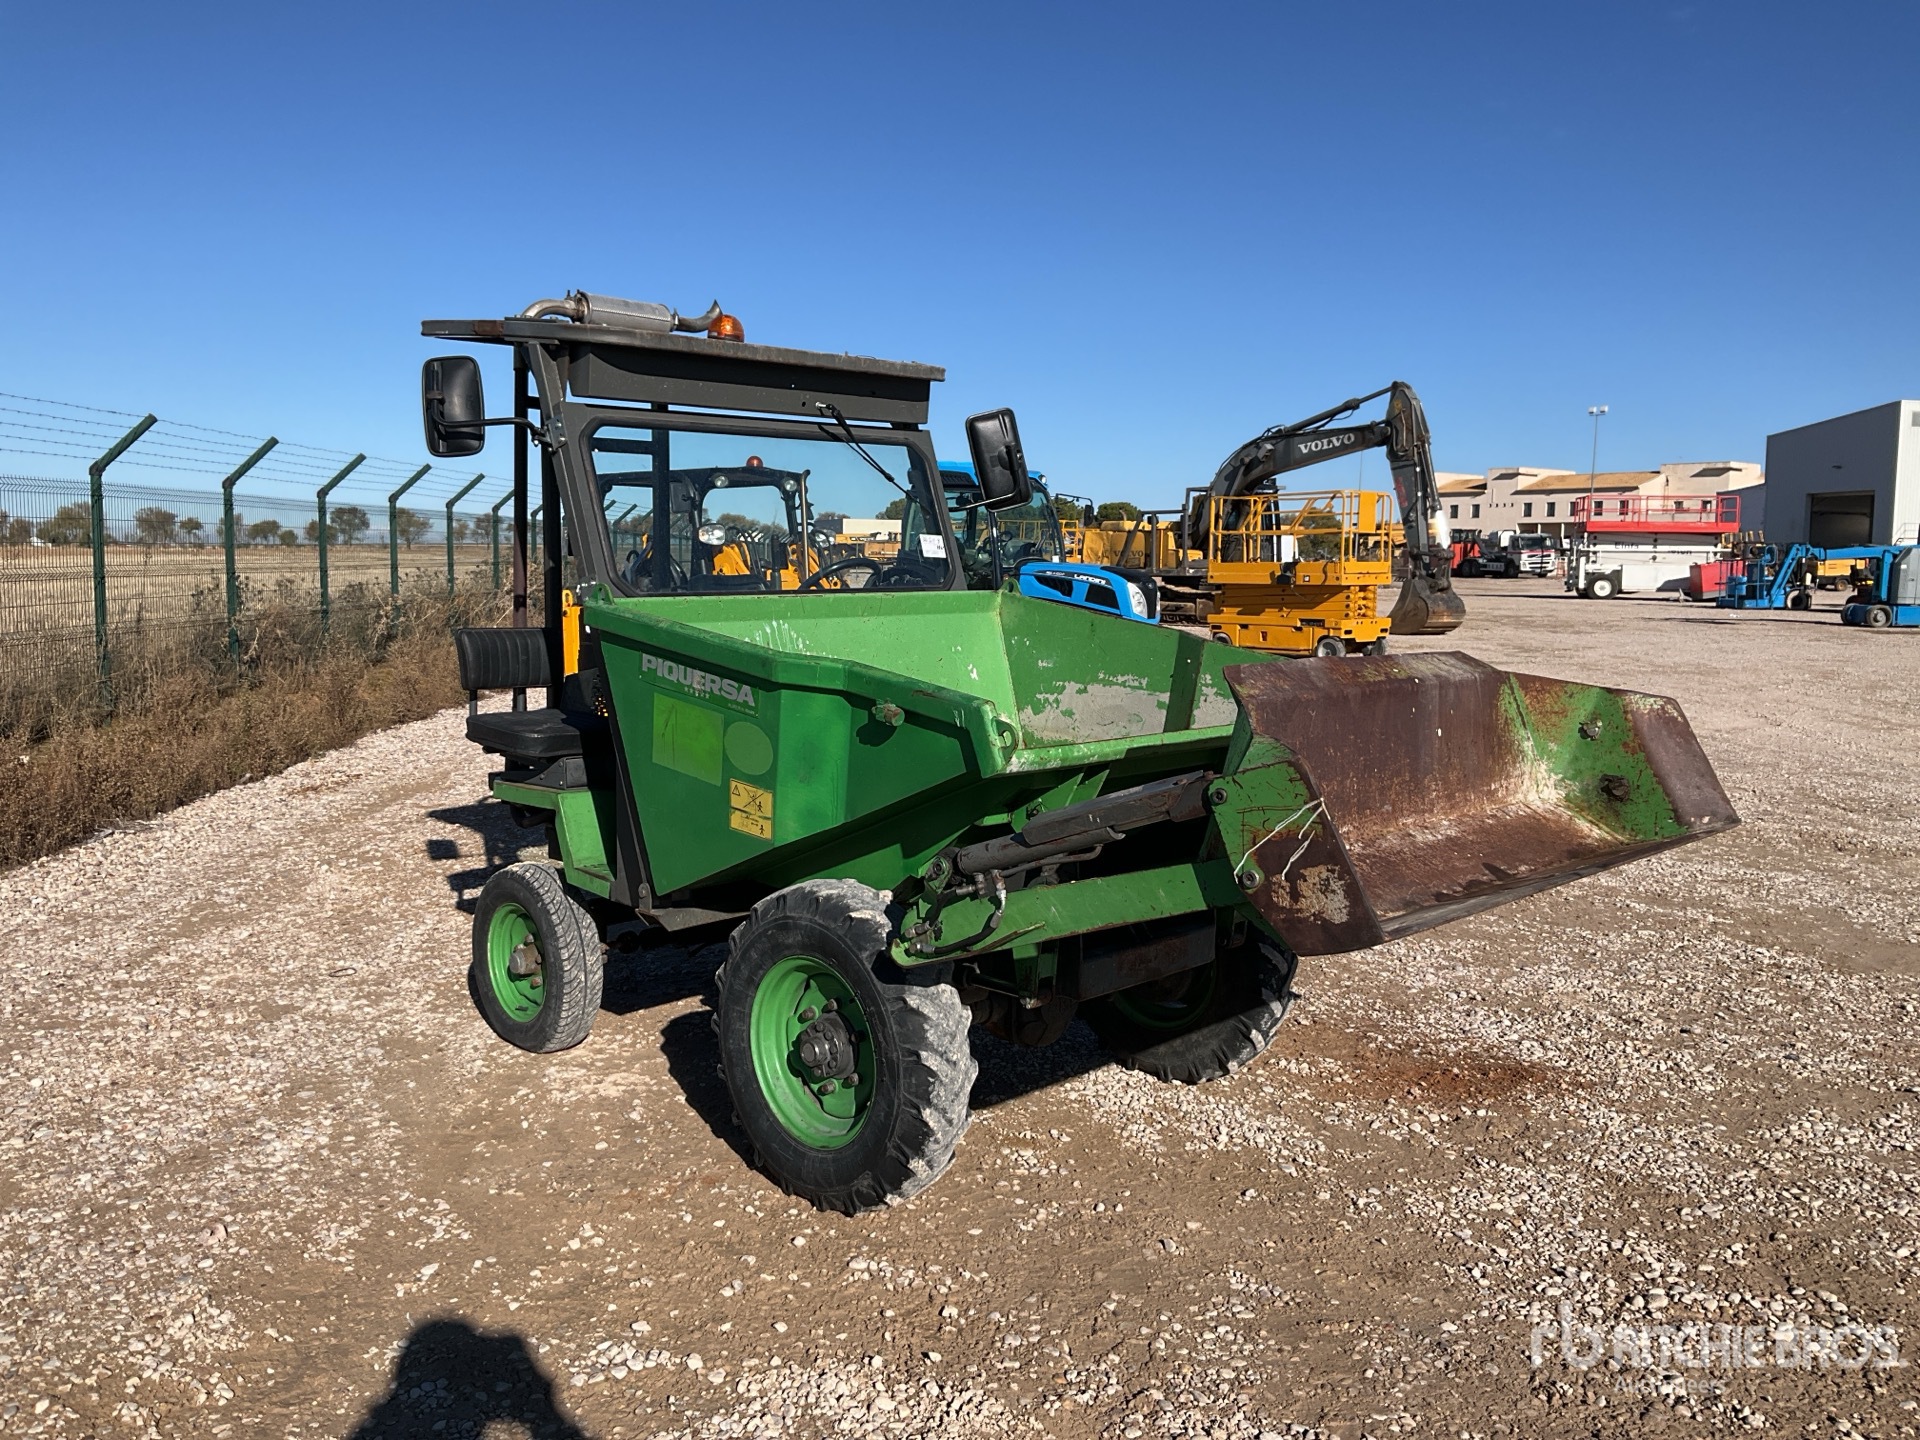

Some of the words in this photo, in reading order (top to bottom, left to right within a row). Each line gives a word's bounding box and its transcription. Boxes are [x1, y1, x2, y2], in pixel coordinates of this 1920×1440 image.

[1298, 433, 1355, 454] VOLVO
[1113, 550, 1144, 558] VVO
[642, 653, 755, 707] PIQUERSA
